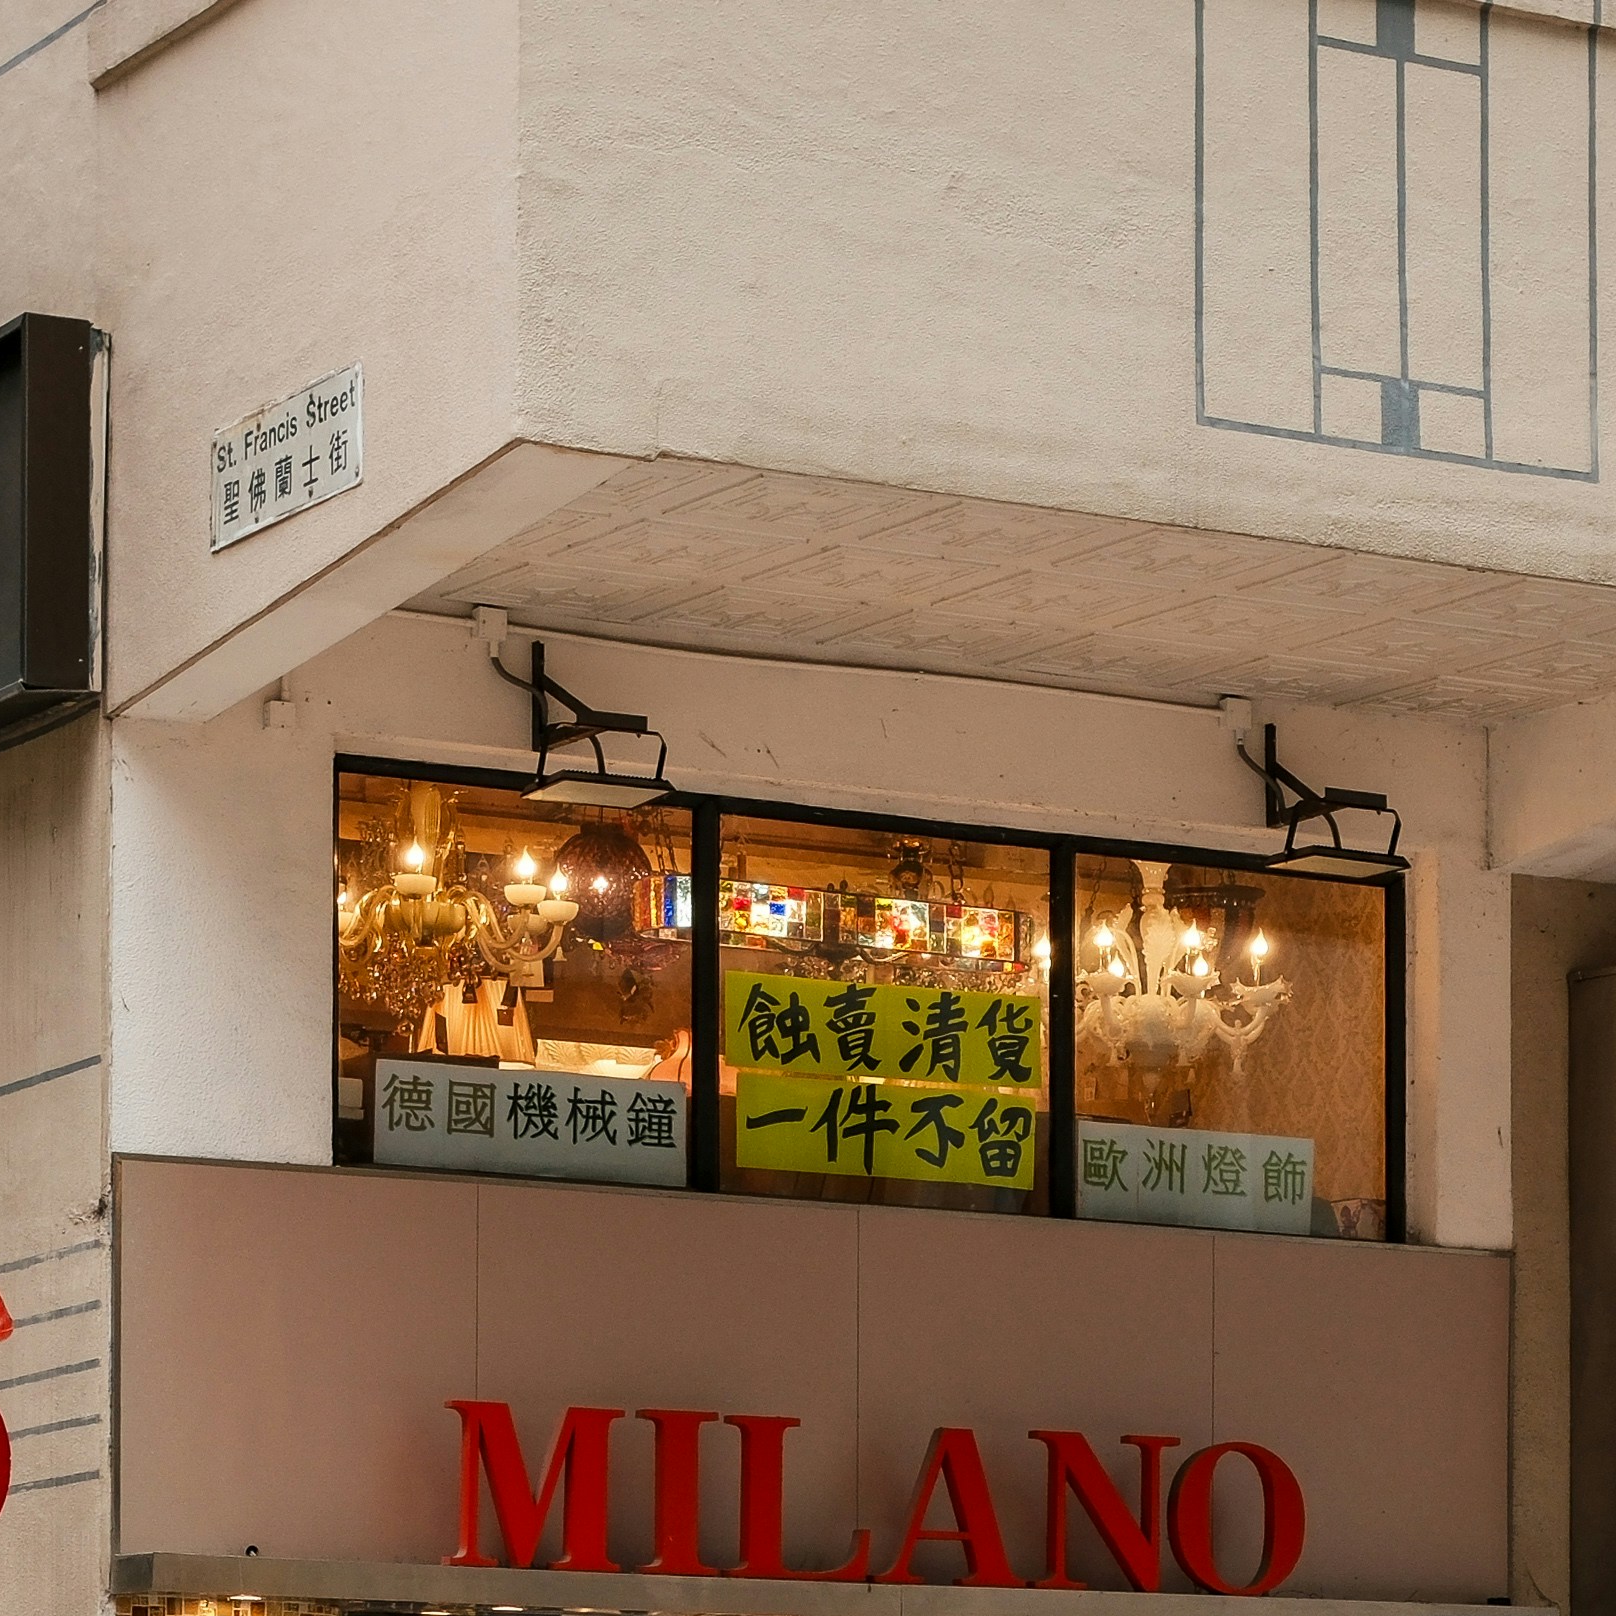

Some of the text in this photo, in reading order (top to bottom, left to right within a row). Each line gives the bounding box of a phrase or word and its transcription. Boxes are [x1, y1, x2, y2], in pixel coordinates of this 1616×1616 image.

[216, 379, 356, 473] St. Francis Street
[223, 429, 349, 525] 聖佛蘭士街
[737, 981, 1037, 1083] 蝕賣清貨
[381, 1072, 678, 1149] 德國機械鐘
[745, 1084, 1034, 1178] 一件不留
[1082, 1136, 1307, 1207] 歐洲燈飾
[440, 1398, 1307, 1598] MILANO
